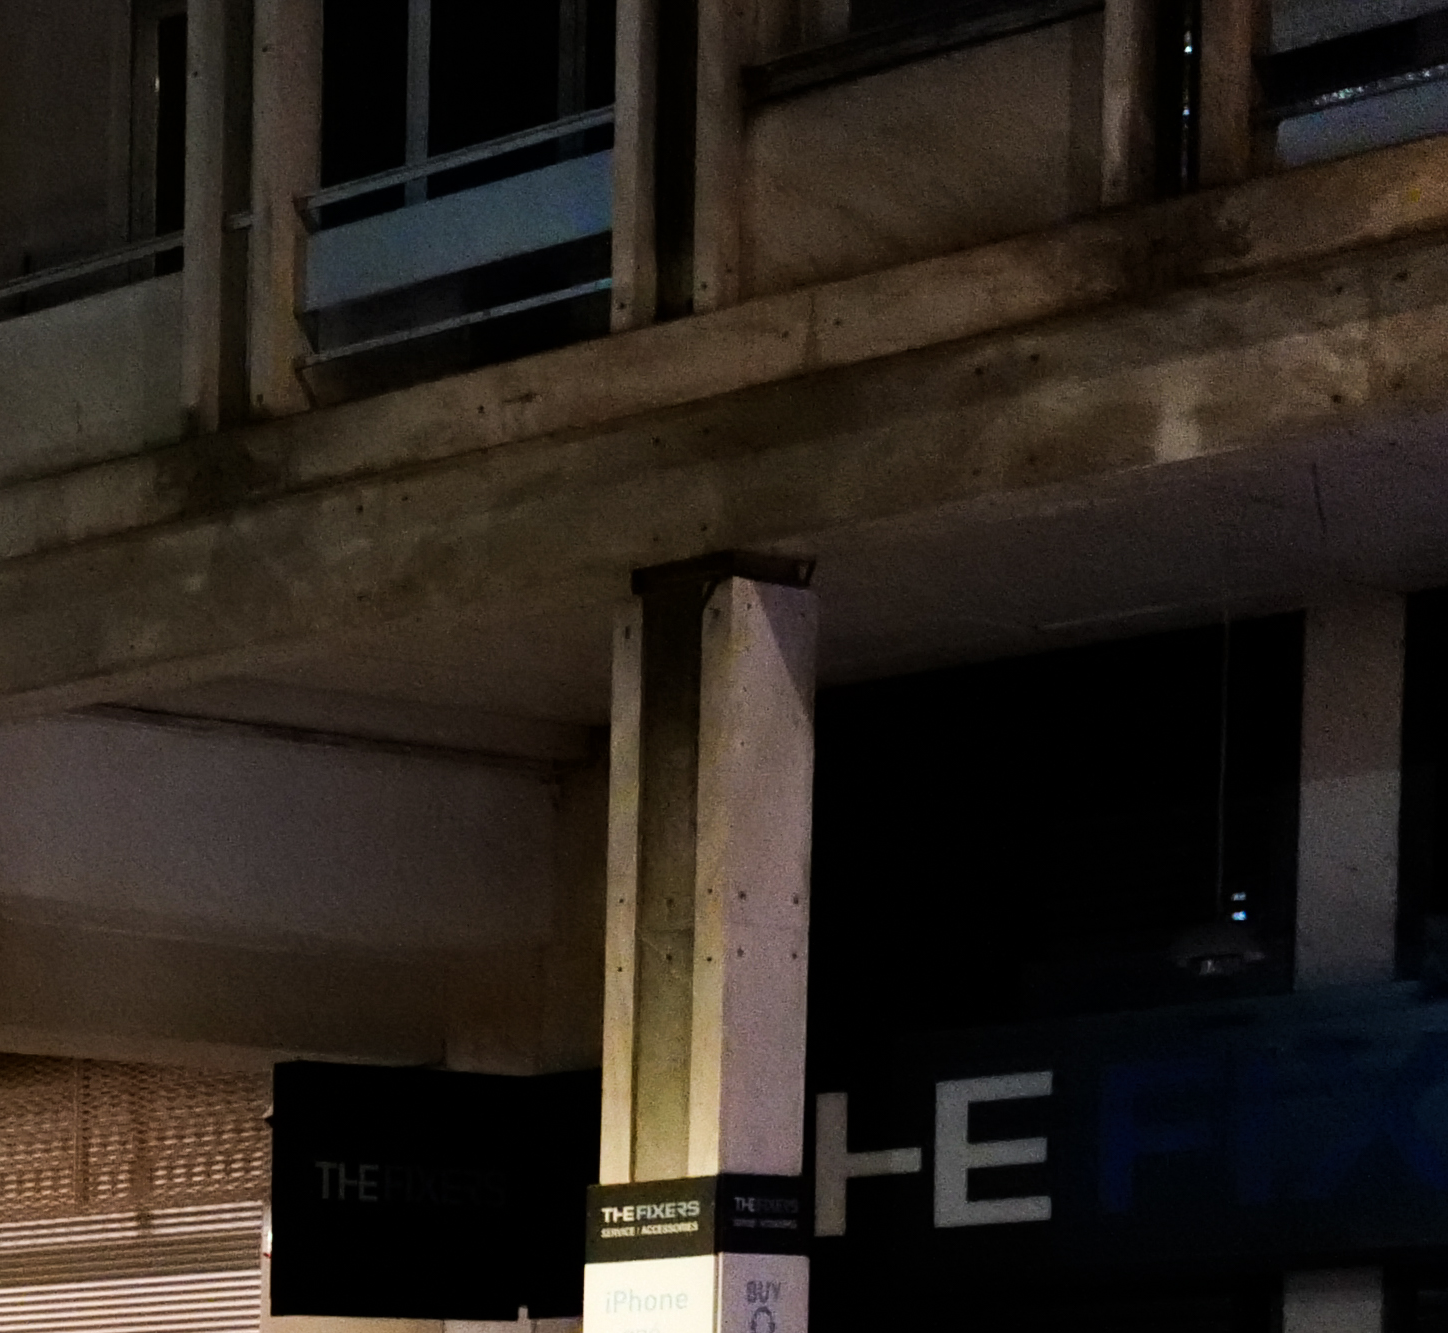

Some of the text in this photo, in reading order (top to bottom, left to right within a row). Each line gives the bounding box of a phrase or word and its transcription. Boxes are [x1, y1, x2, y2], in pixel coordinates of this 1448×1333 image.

[815, 1070, 1054, 1237] HE
[605, 1287, 689, 1314] iPhone
[746, 1280, 782, 1303] BUY
